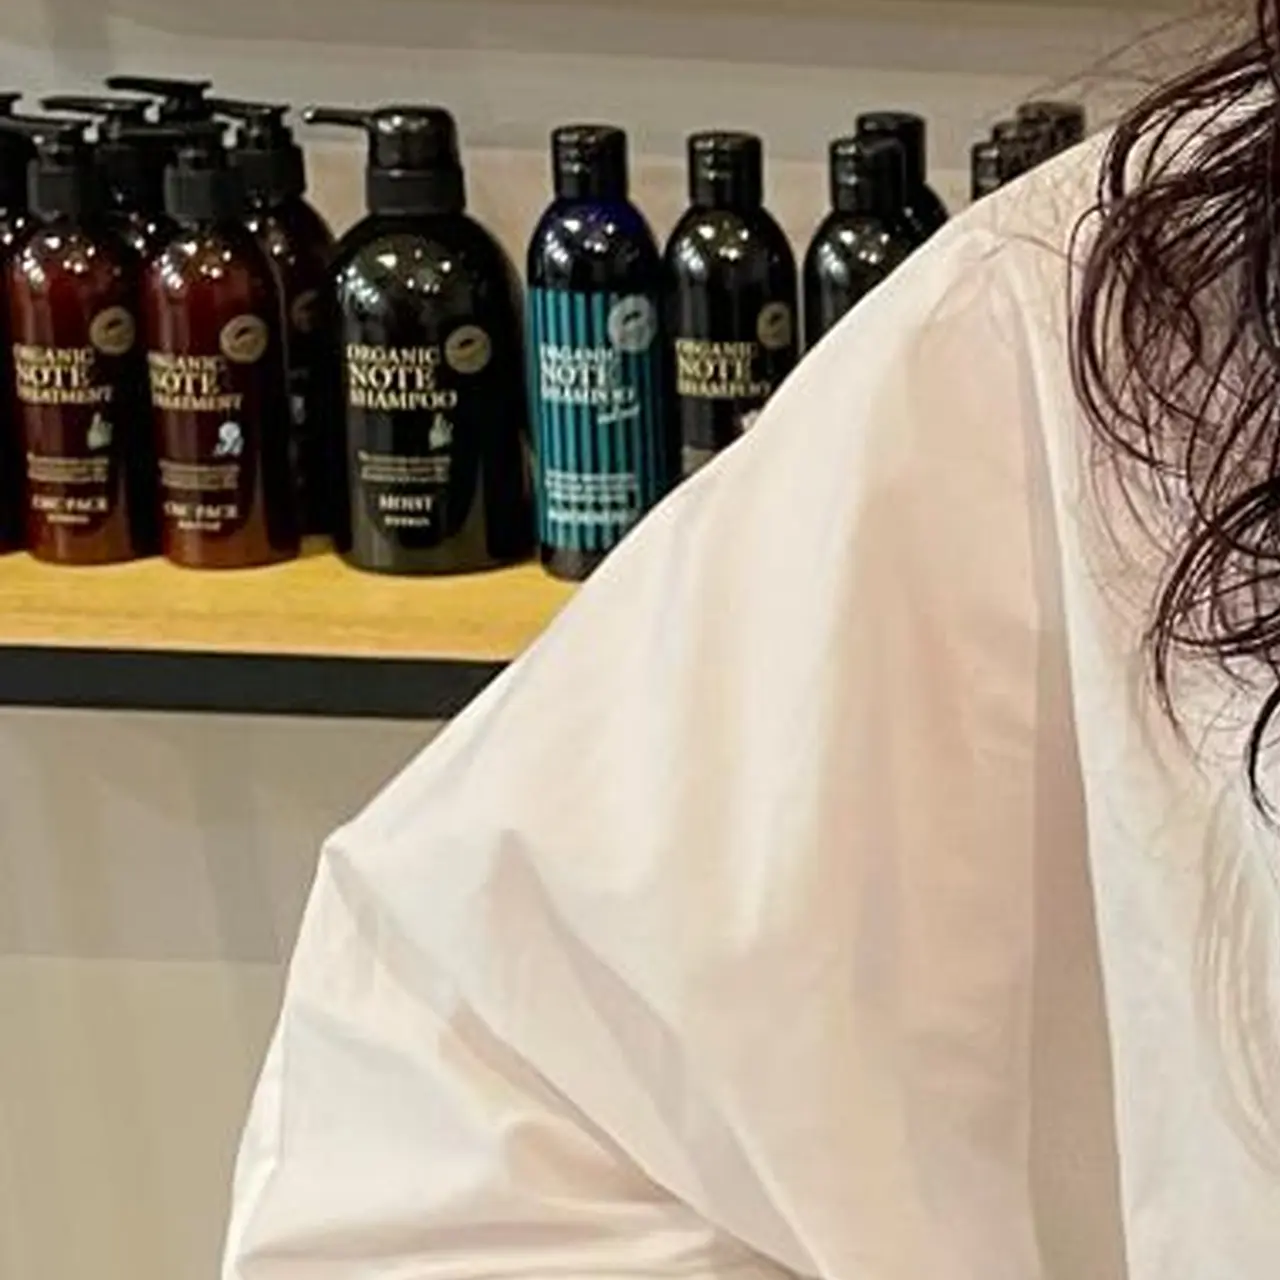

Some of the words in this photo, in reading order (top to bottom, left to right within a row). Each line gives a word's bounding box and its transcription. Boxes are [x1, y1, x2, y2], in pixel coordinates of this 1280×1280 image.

[347, 344, 441, 365] ORGANIC
[349, 361, 436, 390] NOTE
[350, 388, 459, 410] SHAMPOO
